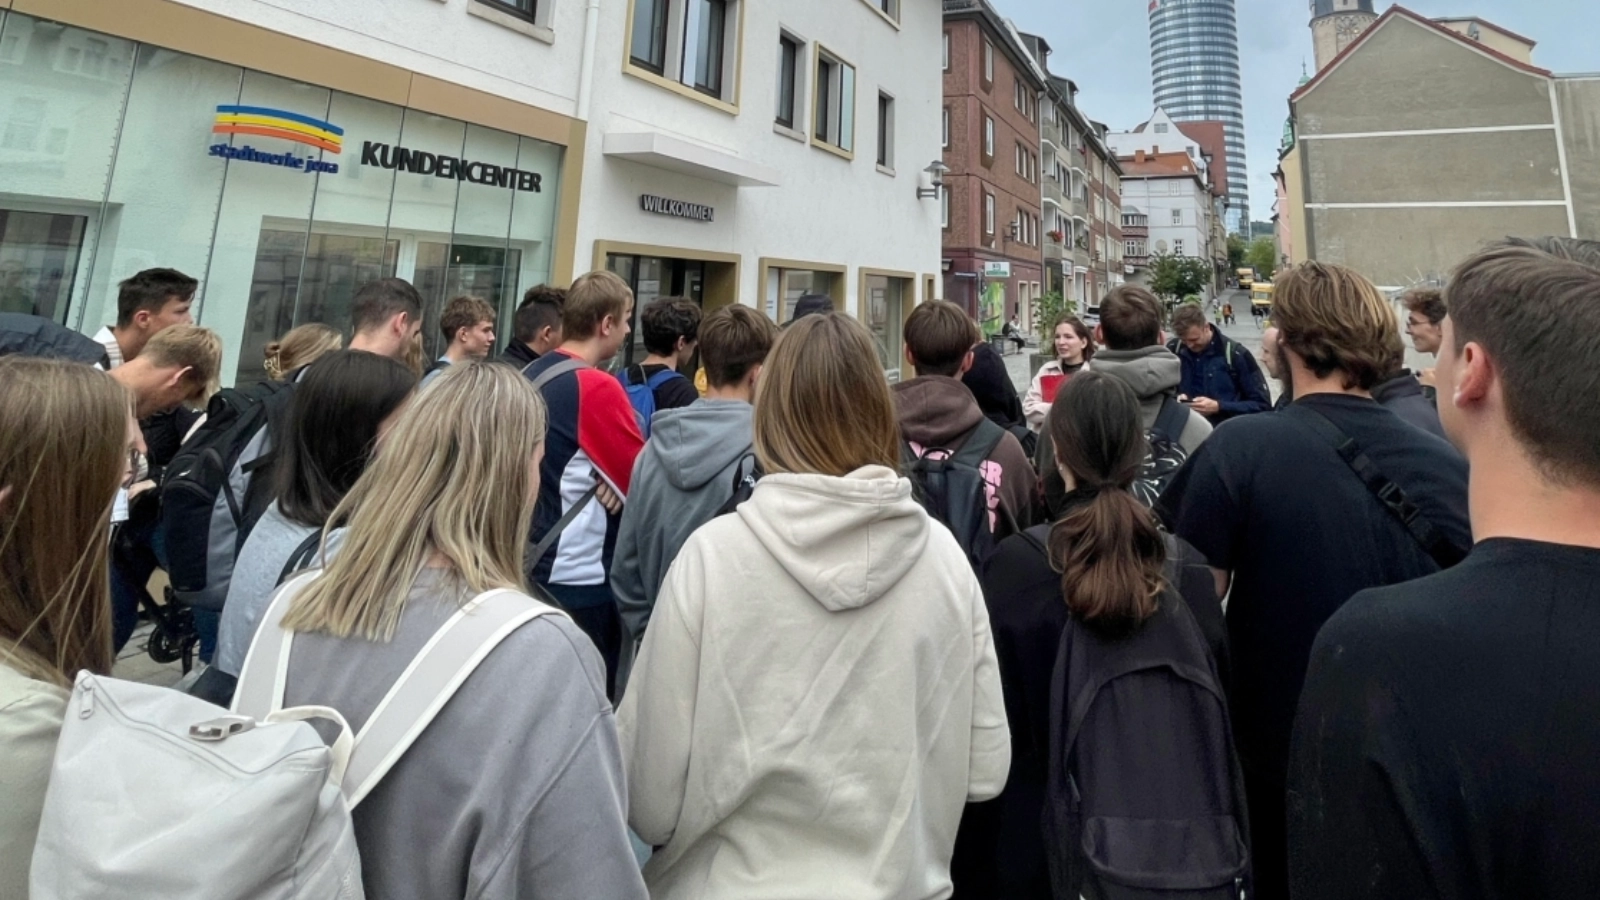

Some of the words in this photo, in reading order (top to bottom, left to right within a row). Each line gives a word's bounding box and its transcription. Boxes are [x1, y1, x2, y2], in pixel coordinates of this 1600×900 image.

[208, 143, 304, 169] stadtwerke
[361, 141, 542, 193] KUNDENCENTER
[641, 194, 715, 222] WILLKOMMEN
